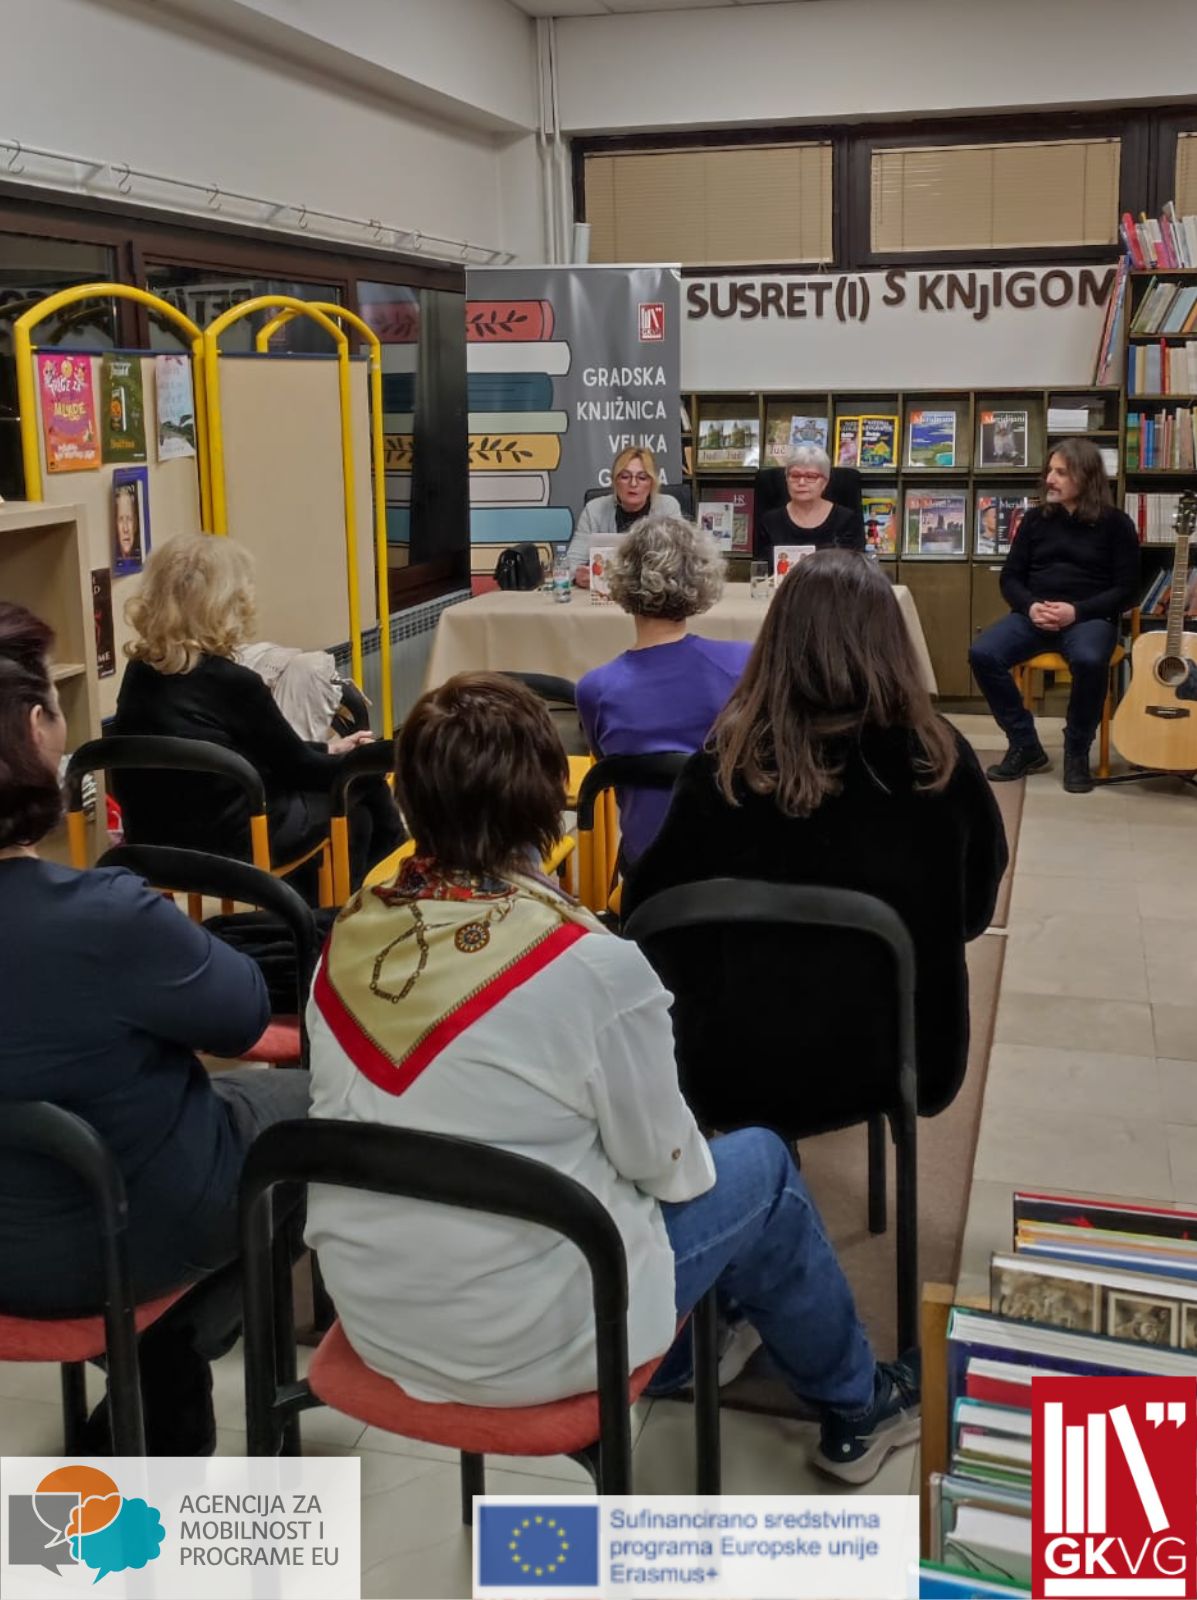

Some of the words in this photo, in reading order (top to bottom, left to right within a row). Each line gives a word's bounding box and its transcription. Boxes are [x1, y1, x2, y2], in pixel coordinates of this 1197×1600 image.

[687, 276, 870, 321] SUSRET(I)
[882, 270, 906, 306] S
[582, 366, 666, 387] GRADSKA
[576, 396, 667, 421] KNJIŽNICA
